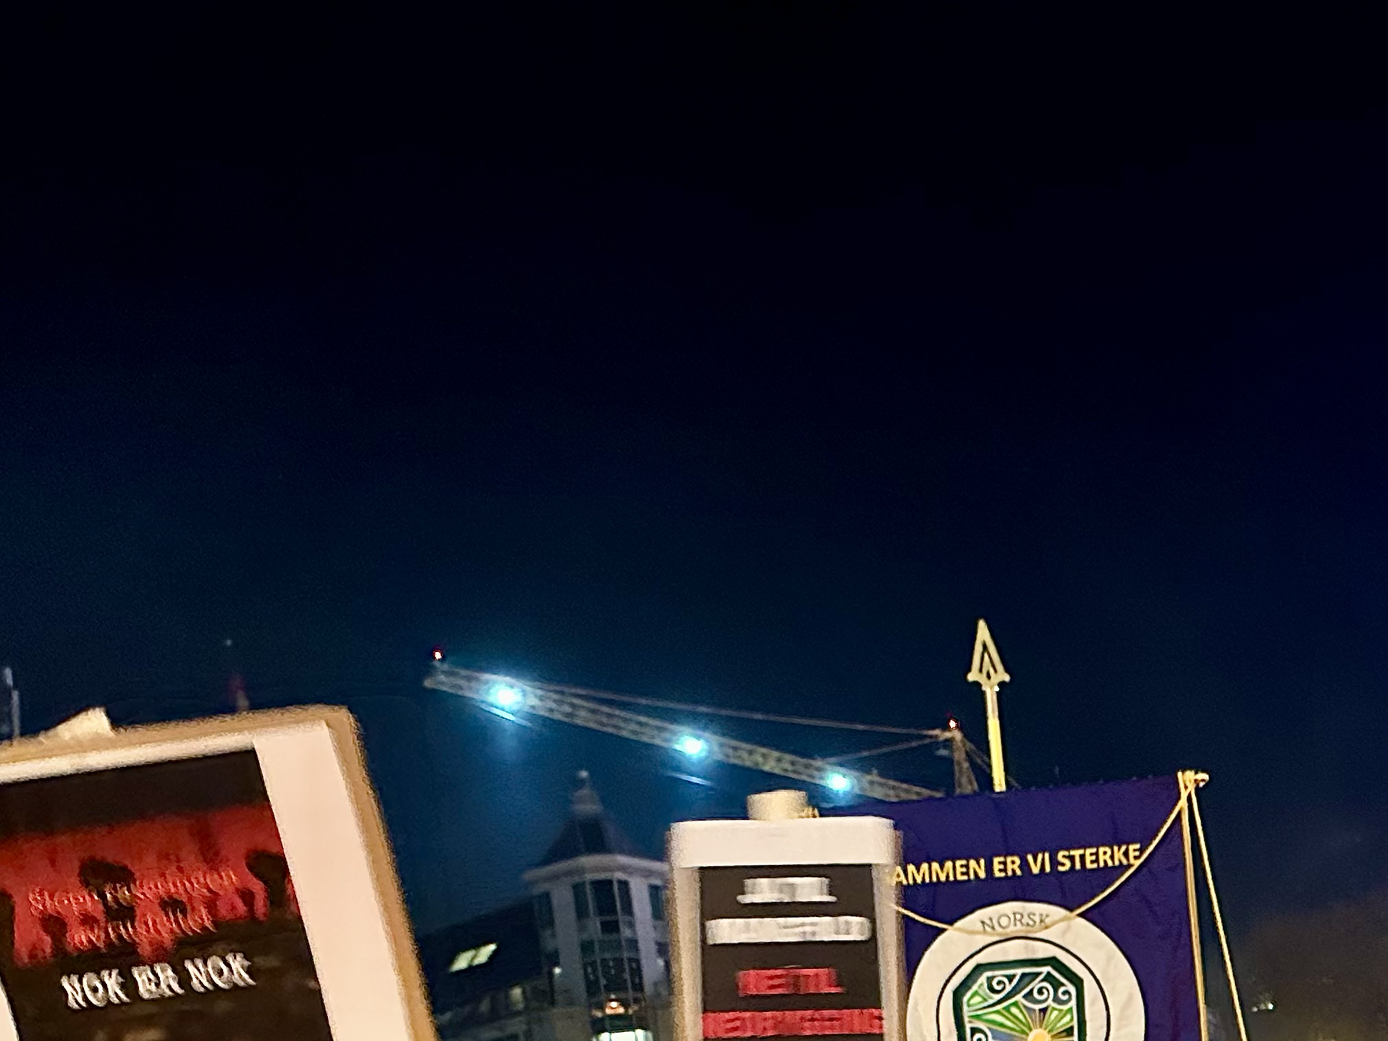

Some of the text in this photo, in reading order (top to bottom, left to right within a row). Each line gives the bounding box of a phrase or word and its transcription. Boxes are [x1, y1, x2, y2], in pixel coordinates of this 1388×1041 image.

[892, 843, 1141, 886] AMMEN ER VI STERKE
[980, 911, 1050, 933] NORSK
[60, 968, 132, 1010] NOK
[184, 952, 257, 993] NOK
